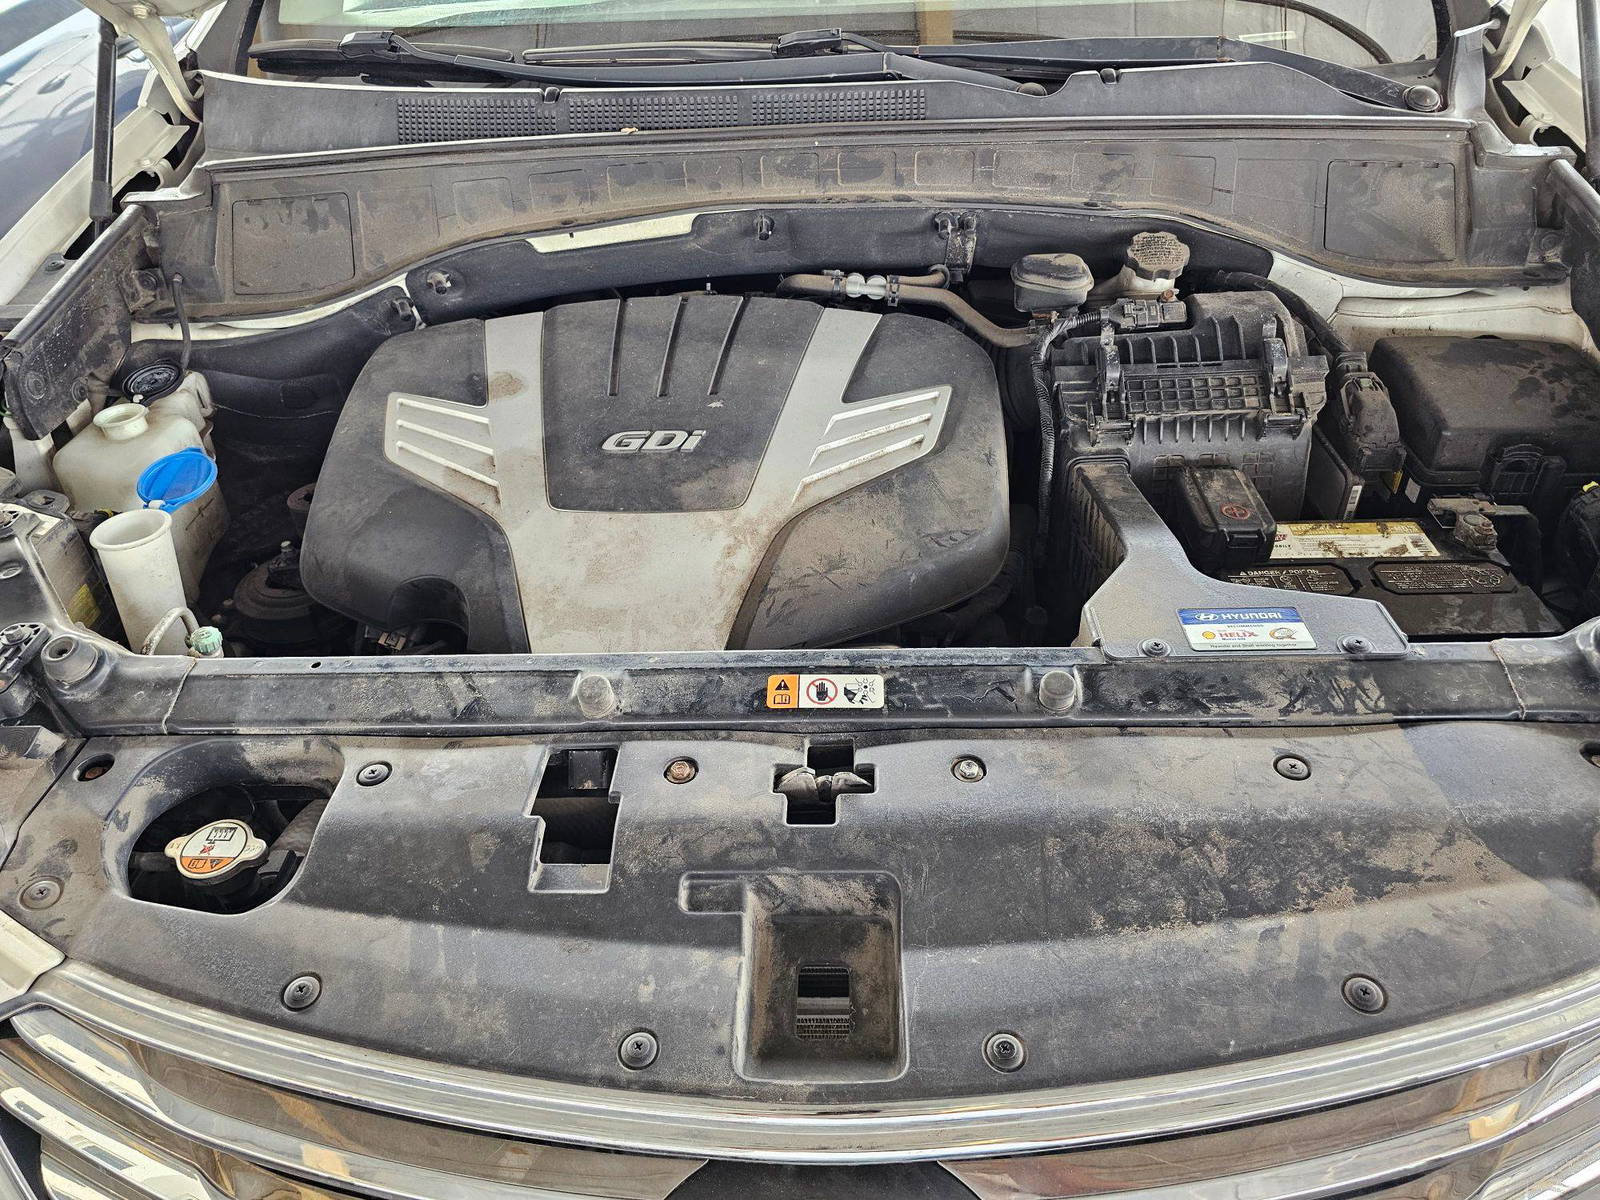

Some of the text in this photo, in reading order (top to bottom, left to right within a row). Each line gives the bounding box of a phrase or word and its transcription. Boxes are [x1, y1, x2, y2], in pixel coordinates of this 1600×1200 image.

[601, 430, 706, 453] GDi
[1221, 612, 1282, 620] HYUNDAI
[1219, 630, 1259, 638] HELIX
